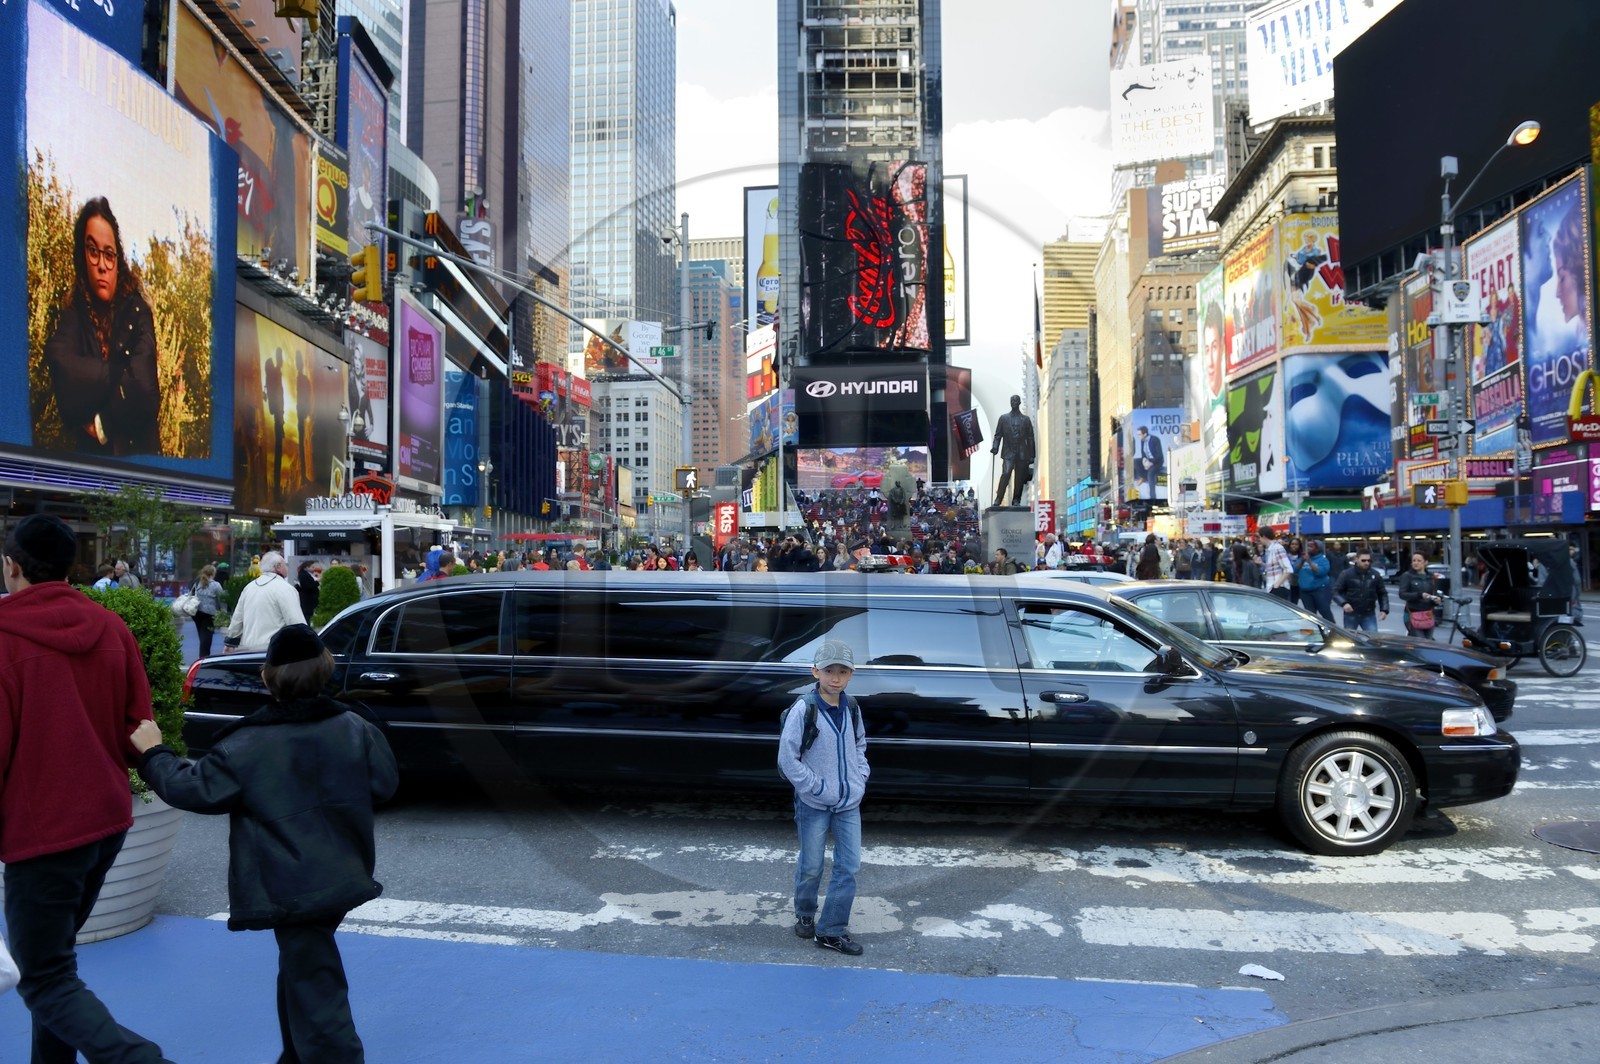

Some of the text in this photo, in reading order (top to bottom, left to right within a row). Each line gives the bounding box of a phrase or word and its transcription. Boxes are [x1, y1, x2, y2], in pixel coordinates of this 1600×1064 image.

[1123, 111, 1204, 133] THE BEST
[1161, 186, 1226, 215] SUPER
[1530, 348, 1589, 393] GHOST
[841, 380, 918, 395] HYUNDAI
[1150, 414, 1181, 424] men
[304, 493, 372, 510] snackBOX
[720, 505, 735, 533] tkts
[1038, 503, 1052, 531] tkts
